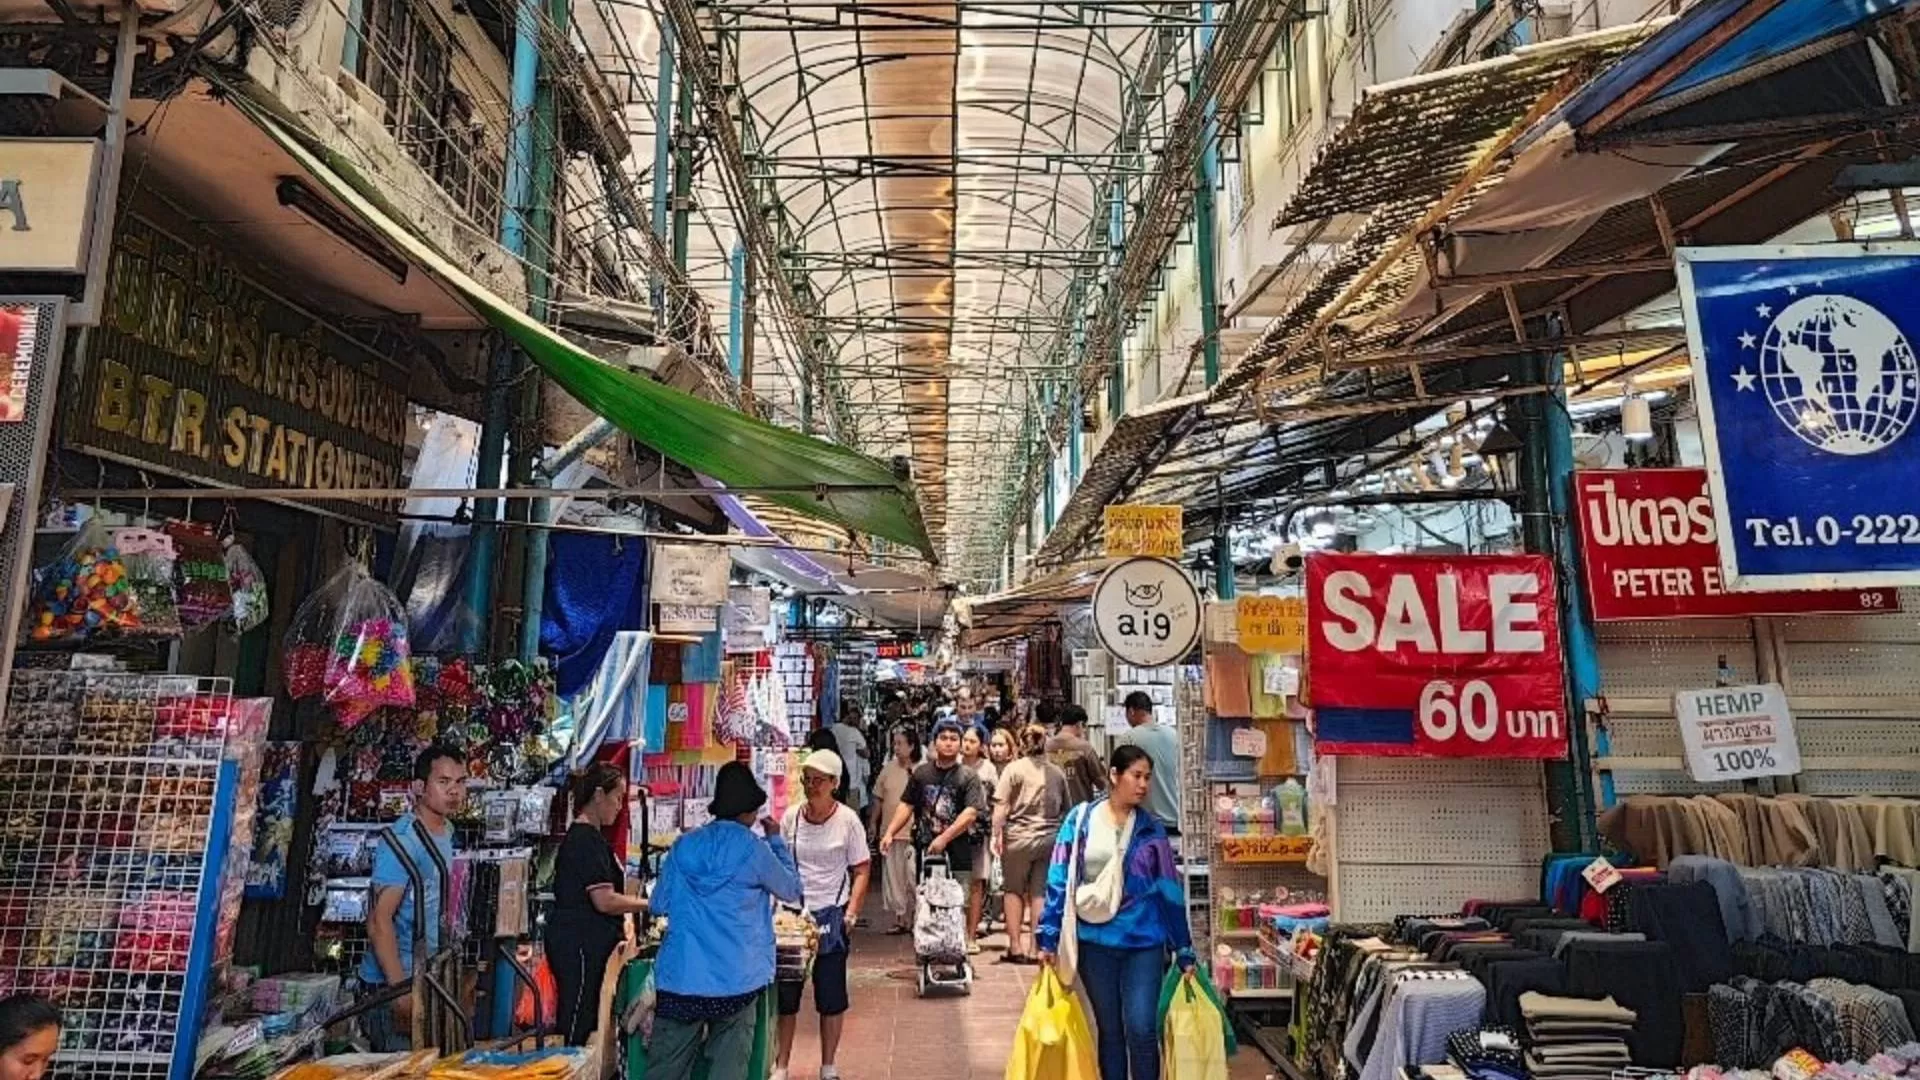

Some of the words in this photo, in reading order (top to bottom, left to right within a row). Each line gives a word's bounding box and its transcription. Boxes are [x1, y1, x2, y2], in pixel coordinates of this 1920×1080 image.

[9, 307, 39, 398] CEREMONIAL
[97, 357, 212, 461] B.T.R.
[223, 405, 402, 510] STATIONERY
[1612, 567, 1695, 598] PETER
[1702, 565, 1726, 595] E
[1859, 592, 1885, 608] 82
[1321, 570, 1545, 654] SALE
[1419, 679, 1498, 742] 60
[1505, 710, 1559, 738] บาท
[1696, 692, 1764, 716] HEMP
[1713, 747, 1776, 772] 100%
